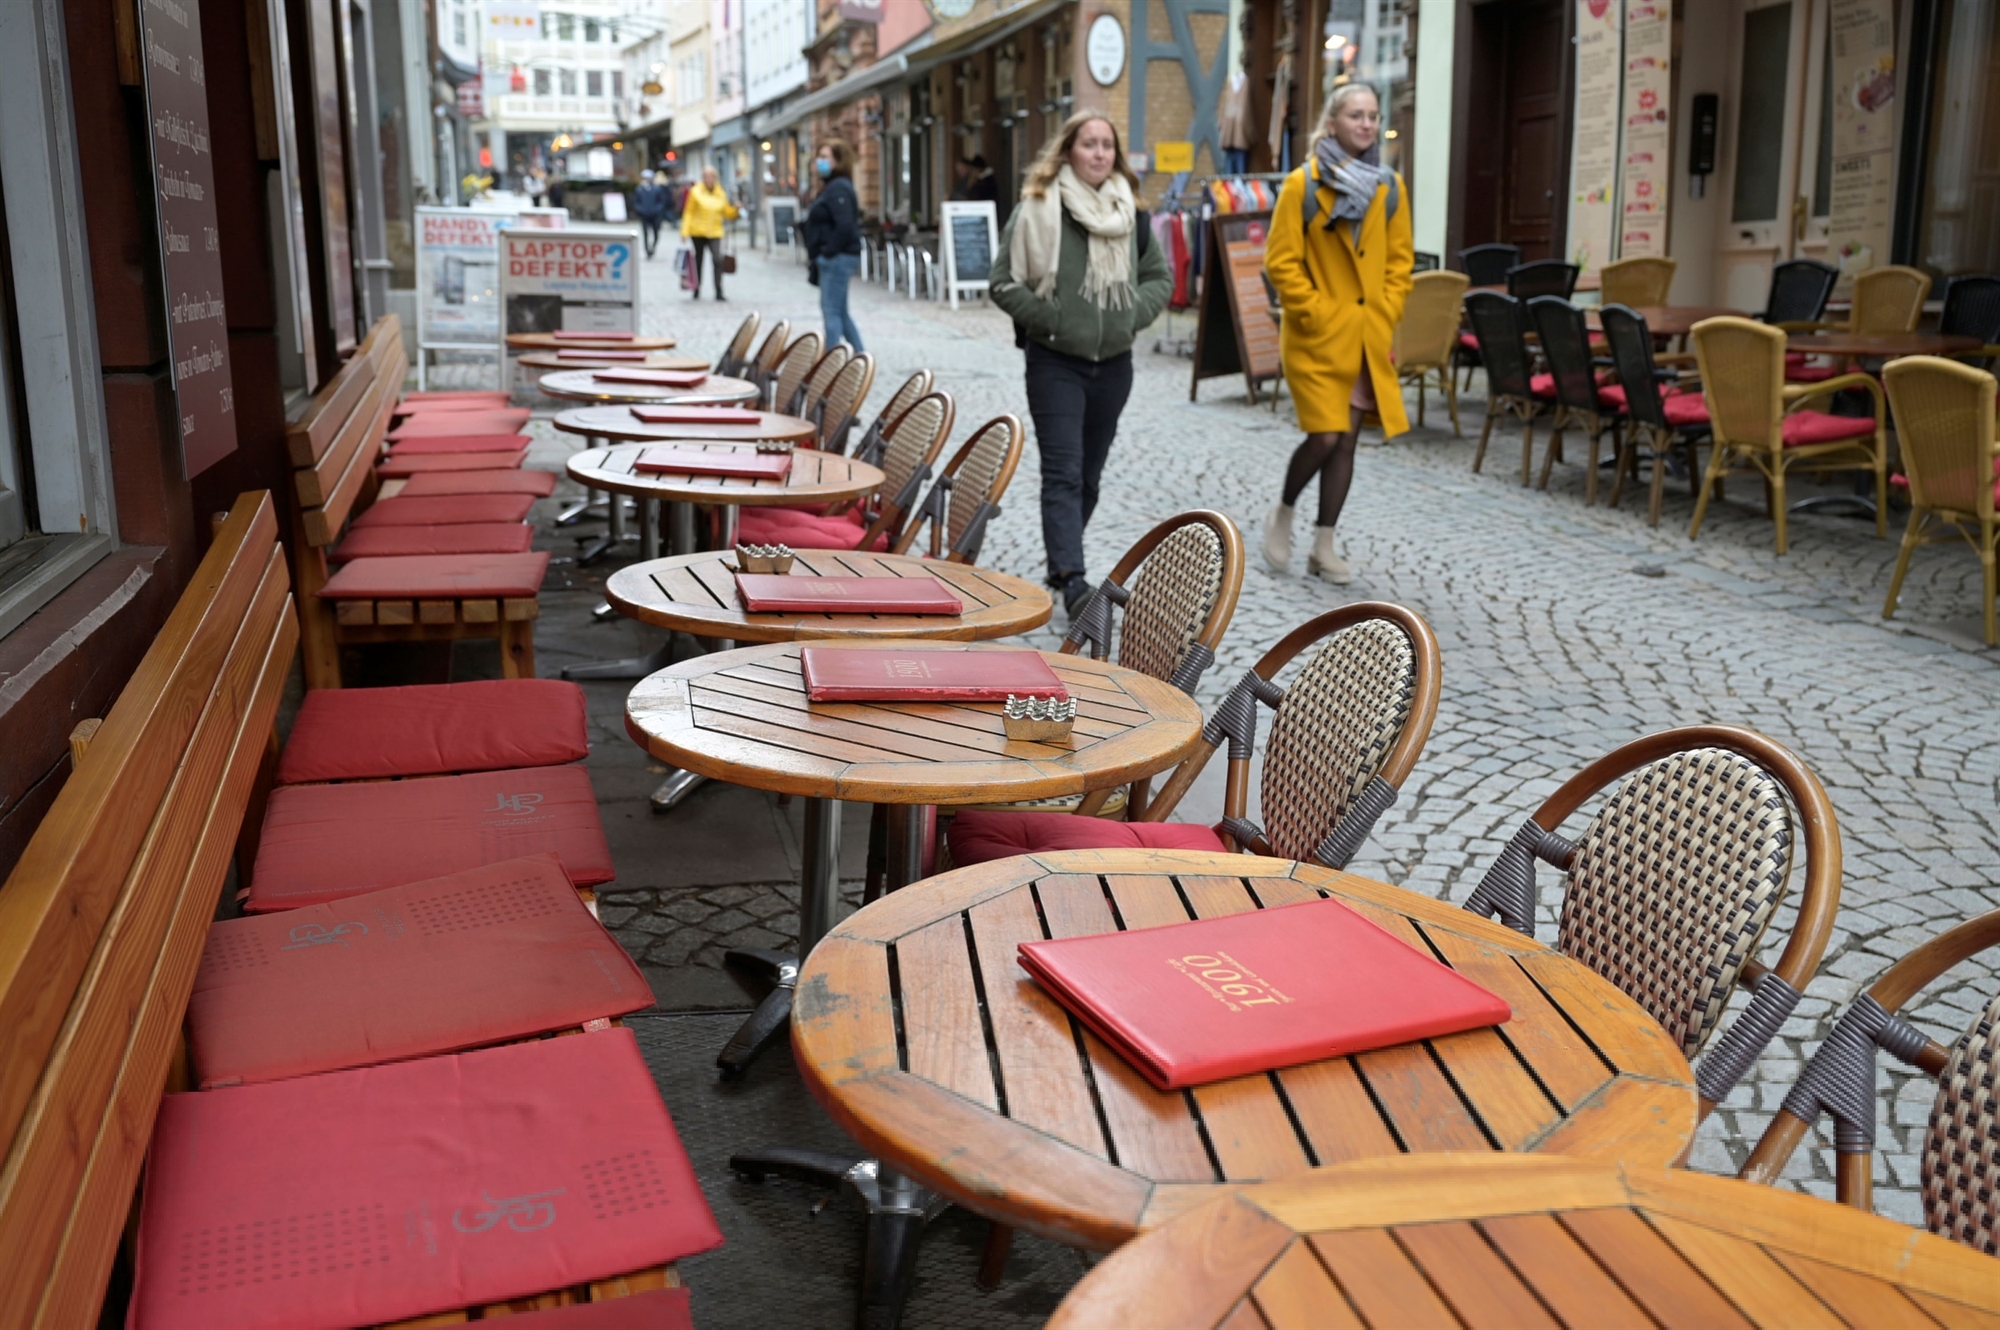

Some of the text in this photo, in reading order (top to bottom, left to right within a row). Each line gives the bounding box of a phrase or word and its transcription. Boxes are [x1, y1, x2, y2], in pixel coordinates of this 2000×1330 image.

[424, 233, 494, 246] DEFEKT
[508, 241, 603, 259] LAPTOP
[509, 260, 607, 278] DEFEKT
[1182, 954, 1281, 1008] 1900
